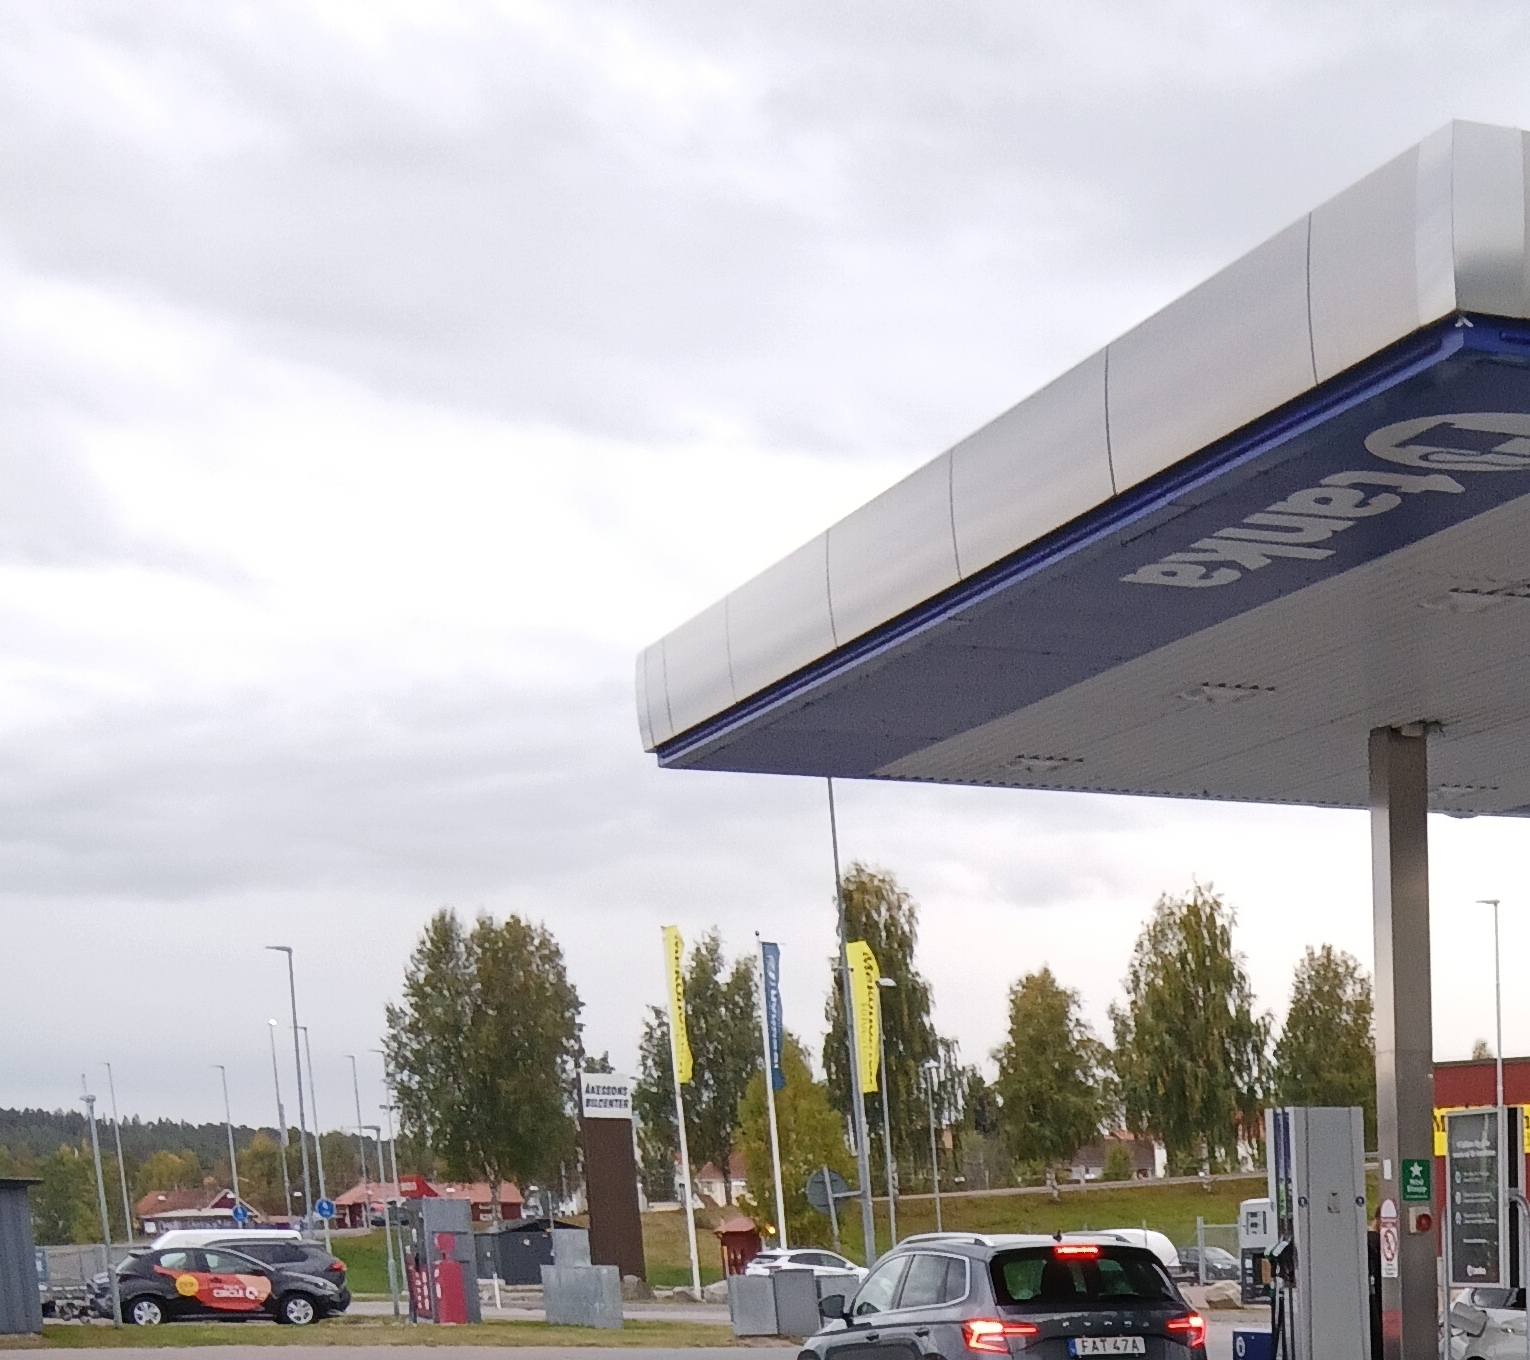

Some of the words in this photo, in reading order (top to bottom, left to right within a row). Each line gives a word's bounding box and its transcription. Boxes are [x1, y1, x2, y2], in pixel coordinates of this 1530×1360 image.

[1119, 470, 1465, 588] tanka
[1081, 1339, 1107, 1353] FAT
[1113, 1338, 1140, 1352] 47A
